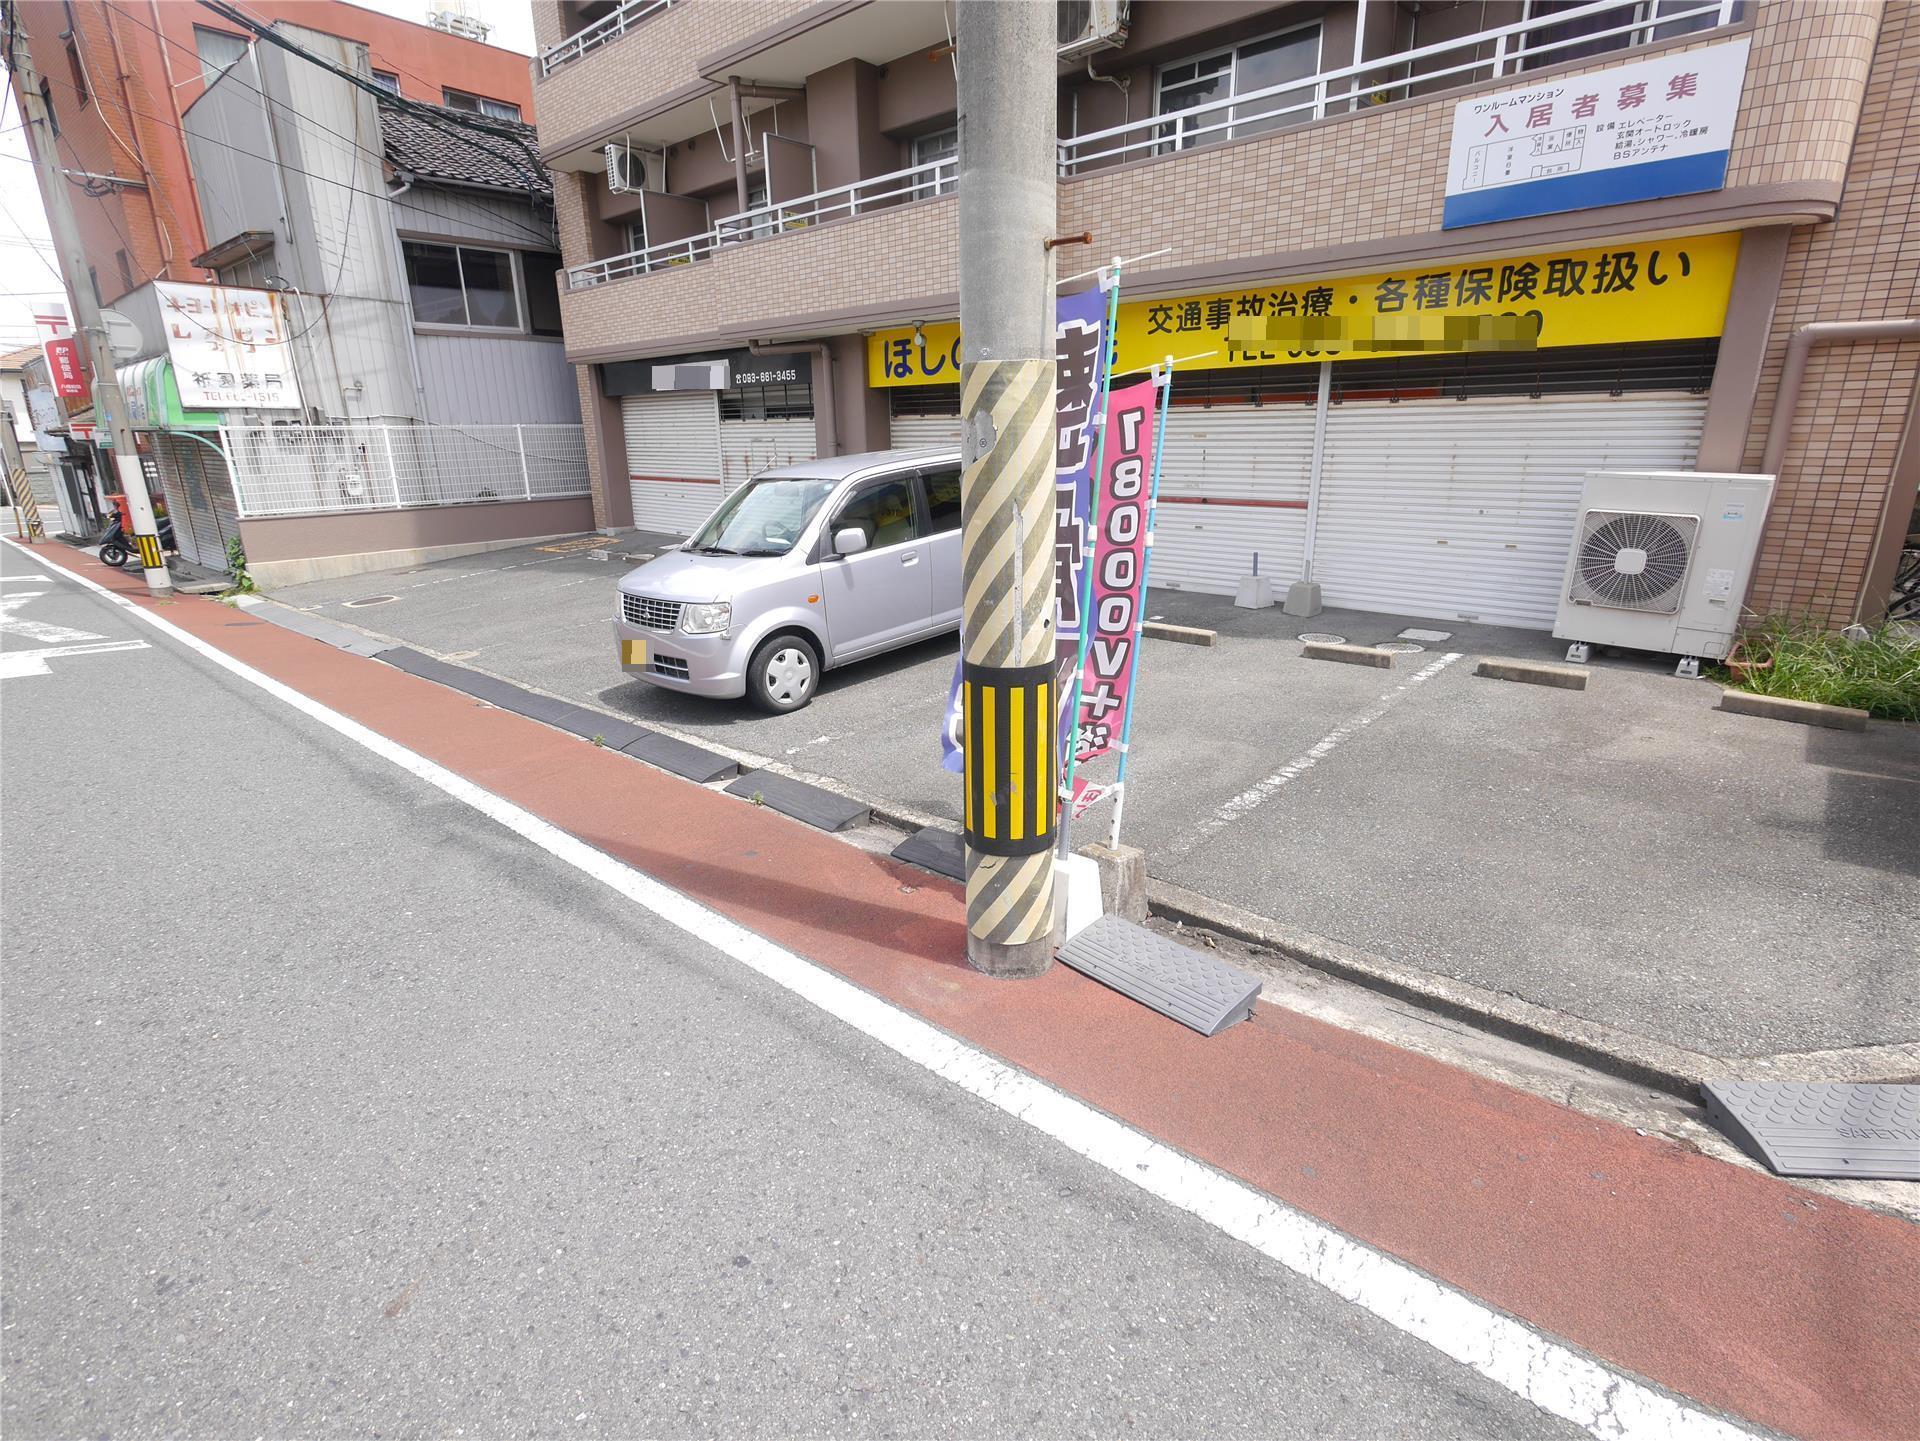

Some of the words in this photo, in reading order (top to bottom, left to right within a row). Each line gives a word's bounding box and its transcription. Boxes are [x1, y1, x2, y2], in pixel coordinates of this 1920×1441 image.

[1474, 88, 1564, 115] ワンルームマンション
[1483, 72, 1698, 138] 入居者募集
[1617, 120, 1692, 140] 玄関オートロック
[884, 334, 960, 379] ほし
